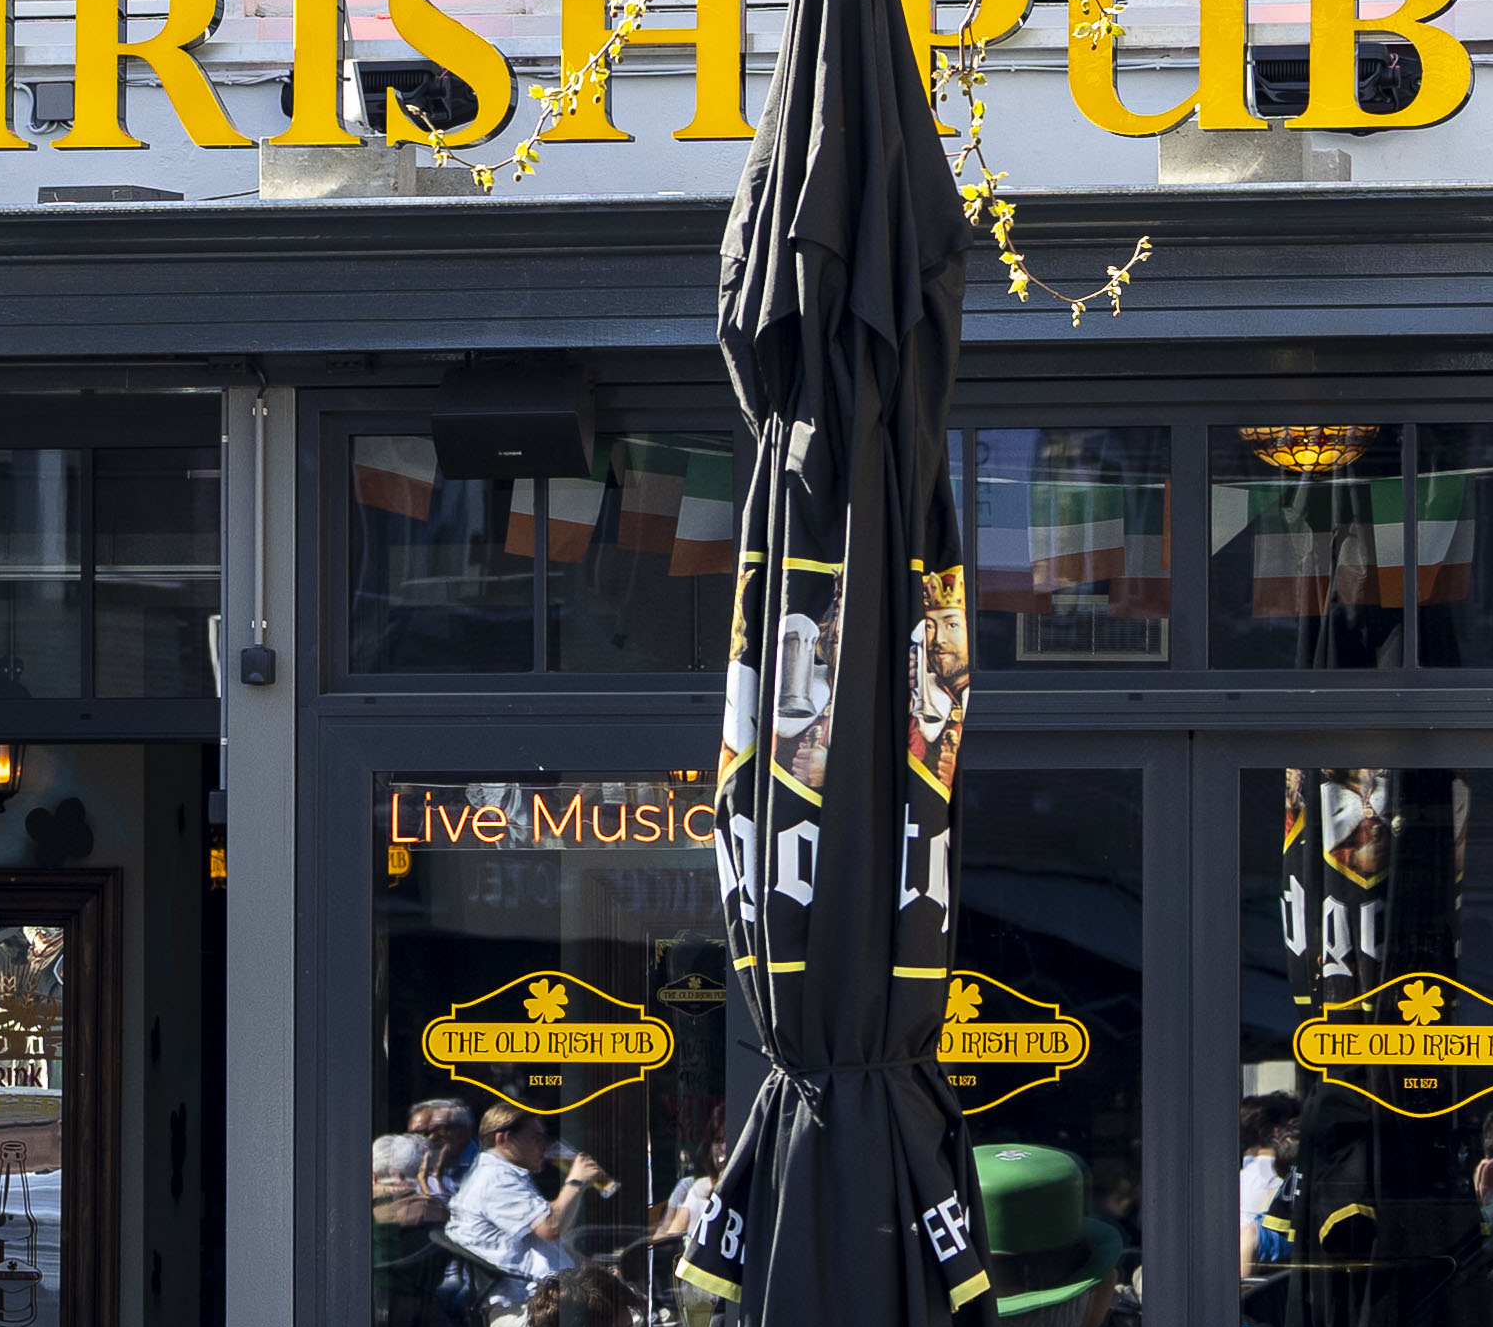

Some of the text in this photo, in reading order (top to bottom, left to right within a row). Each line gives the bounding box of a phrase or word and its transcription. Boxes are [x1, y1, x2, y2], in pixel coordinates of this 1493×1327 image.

[391, 789, 716, 844] Live Music
[442, 1030, 654, 1059] THE OLD IRISH PUB
[961, 1031, 1019, 1059] IRISH
[1025, 1031, 1070, 1054] PUB
[1313, 1033, 1363, 1059] THE
[1368, 1033, 1415, 1056] OLD
[1422, 1033, 1482, 1062] IRISH
